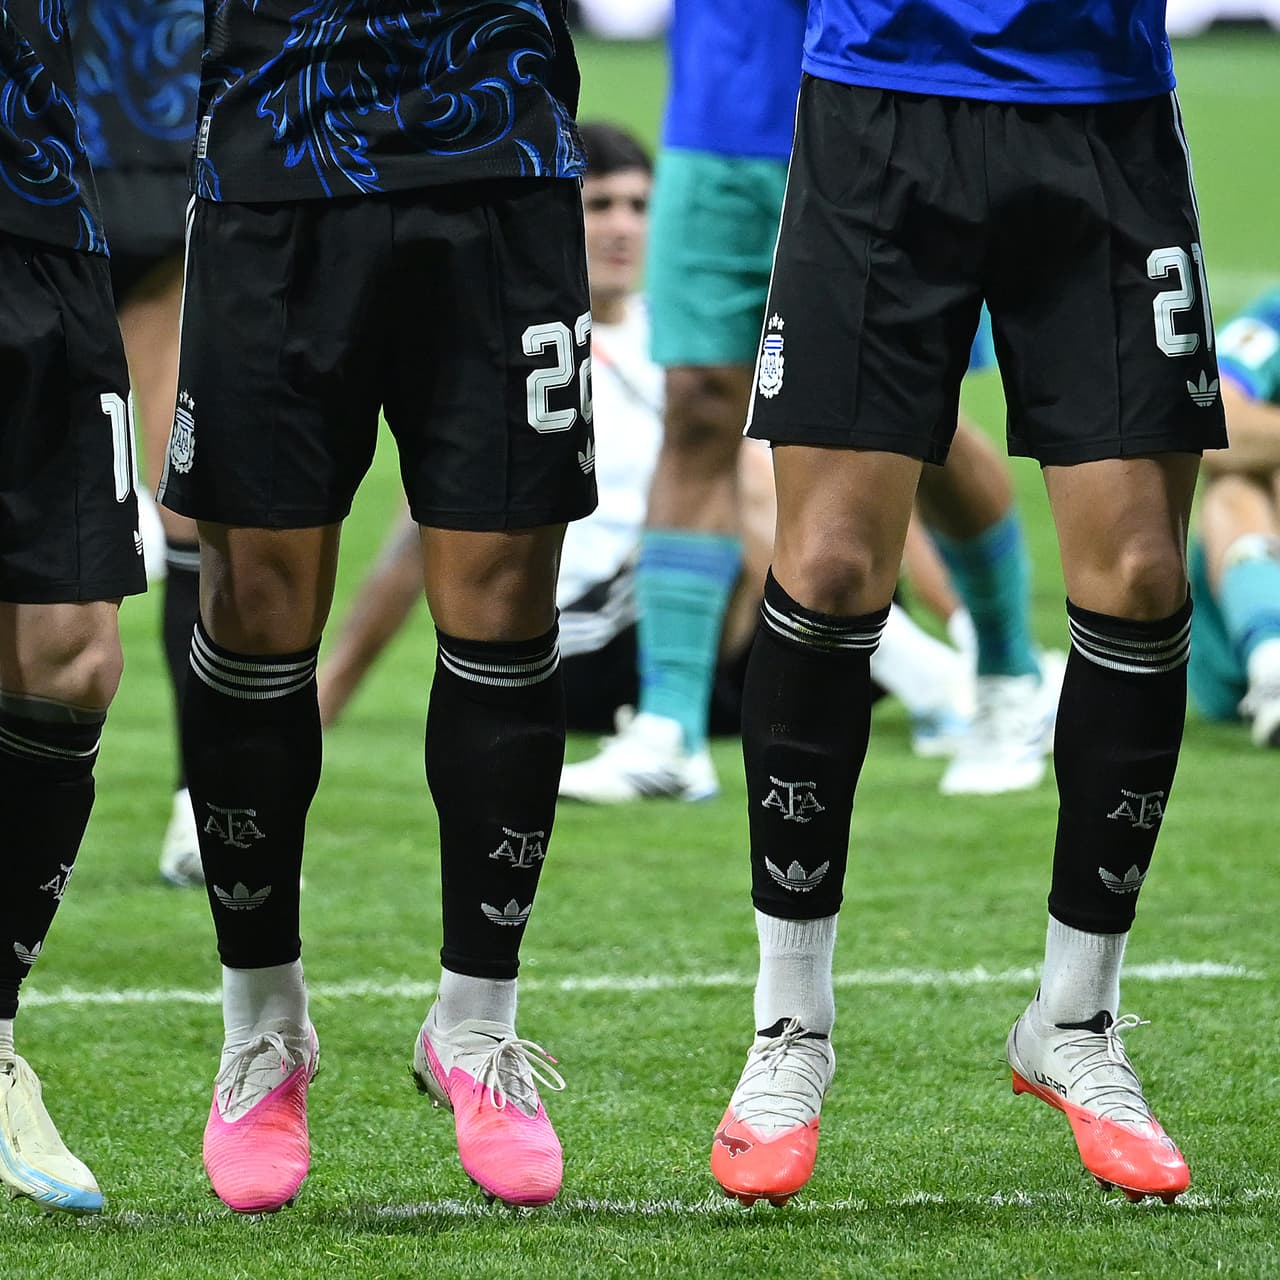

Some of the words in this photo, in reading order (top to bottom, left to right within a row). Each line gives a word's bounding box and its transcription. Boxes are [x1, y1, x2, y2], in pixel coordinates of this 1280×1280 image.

[99, 389, 138, 503] 1
[762, 776, 825, 822] AFA
[1107, 789, 1165, 829] AFA
[204, 802, 266, 848] AFA
[488, 826, 545, 868] AFA
